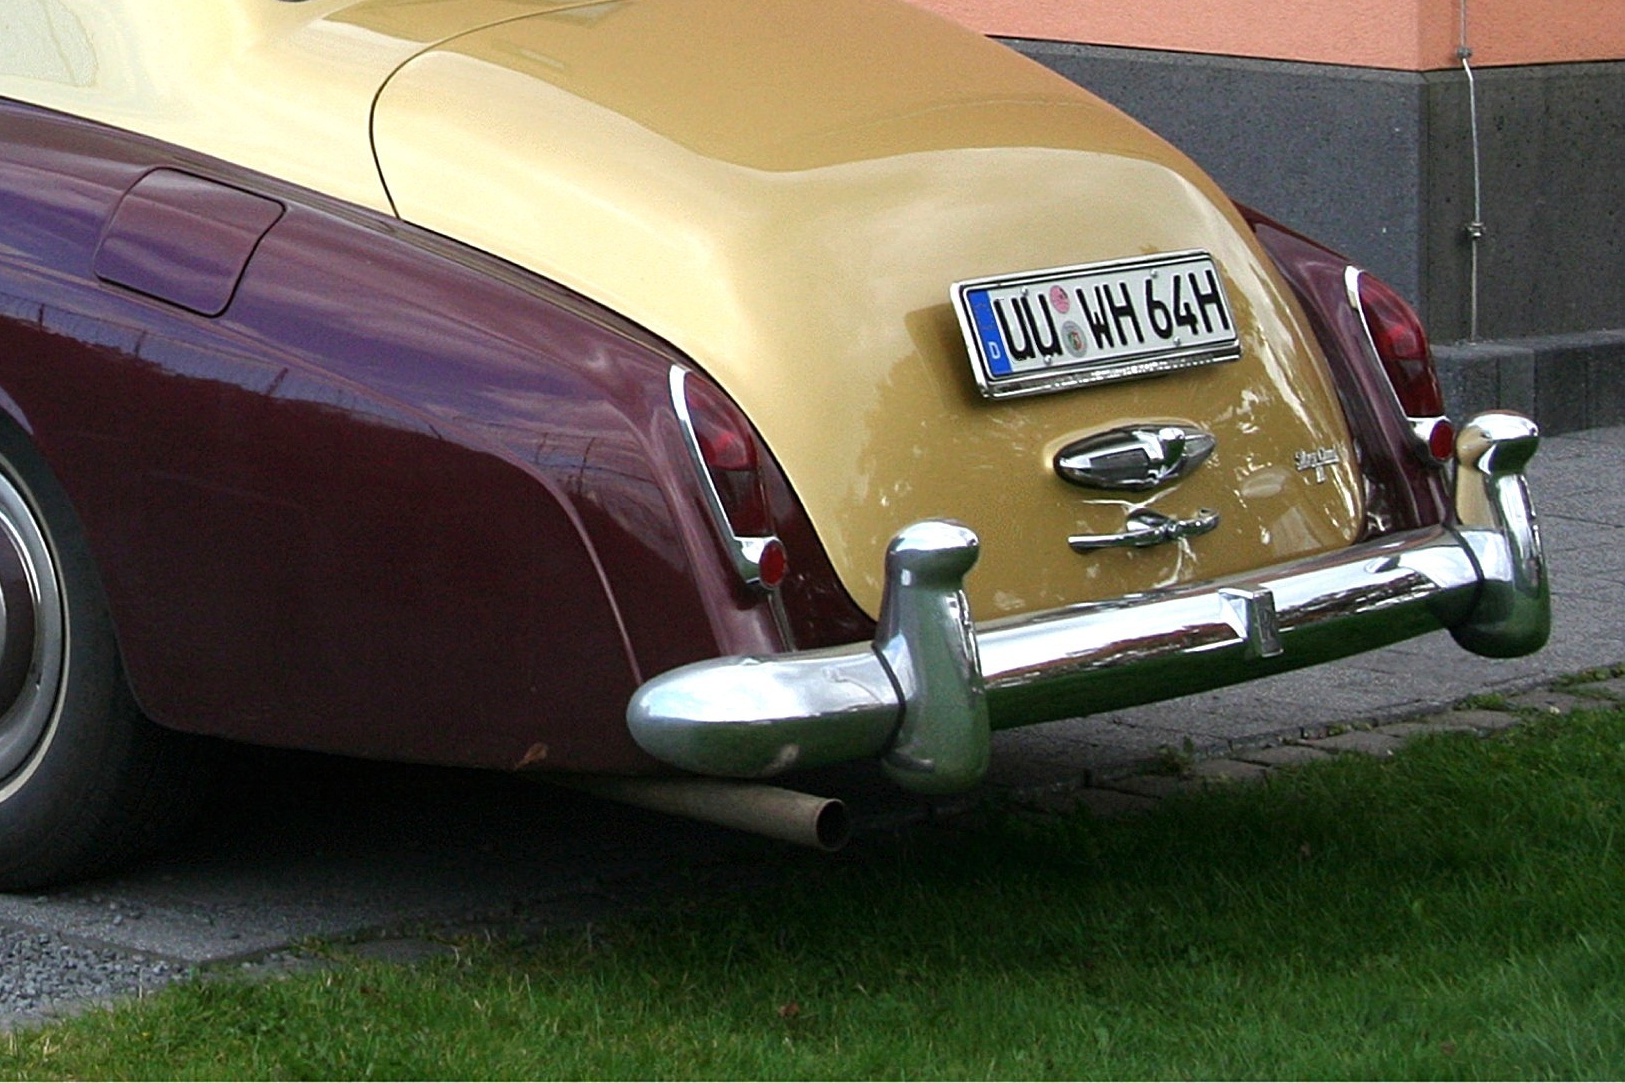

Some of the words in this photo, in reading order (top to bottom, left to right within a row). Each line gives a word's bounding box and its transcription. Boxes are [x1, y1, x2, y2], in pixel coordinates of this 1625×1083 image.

[993, 294, 1063, 361] UU
[1076, 282, 1144, 349] WH
[1145, 269, 1230, 340] 64H
[988, 341, 1001, 359] D
